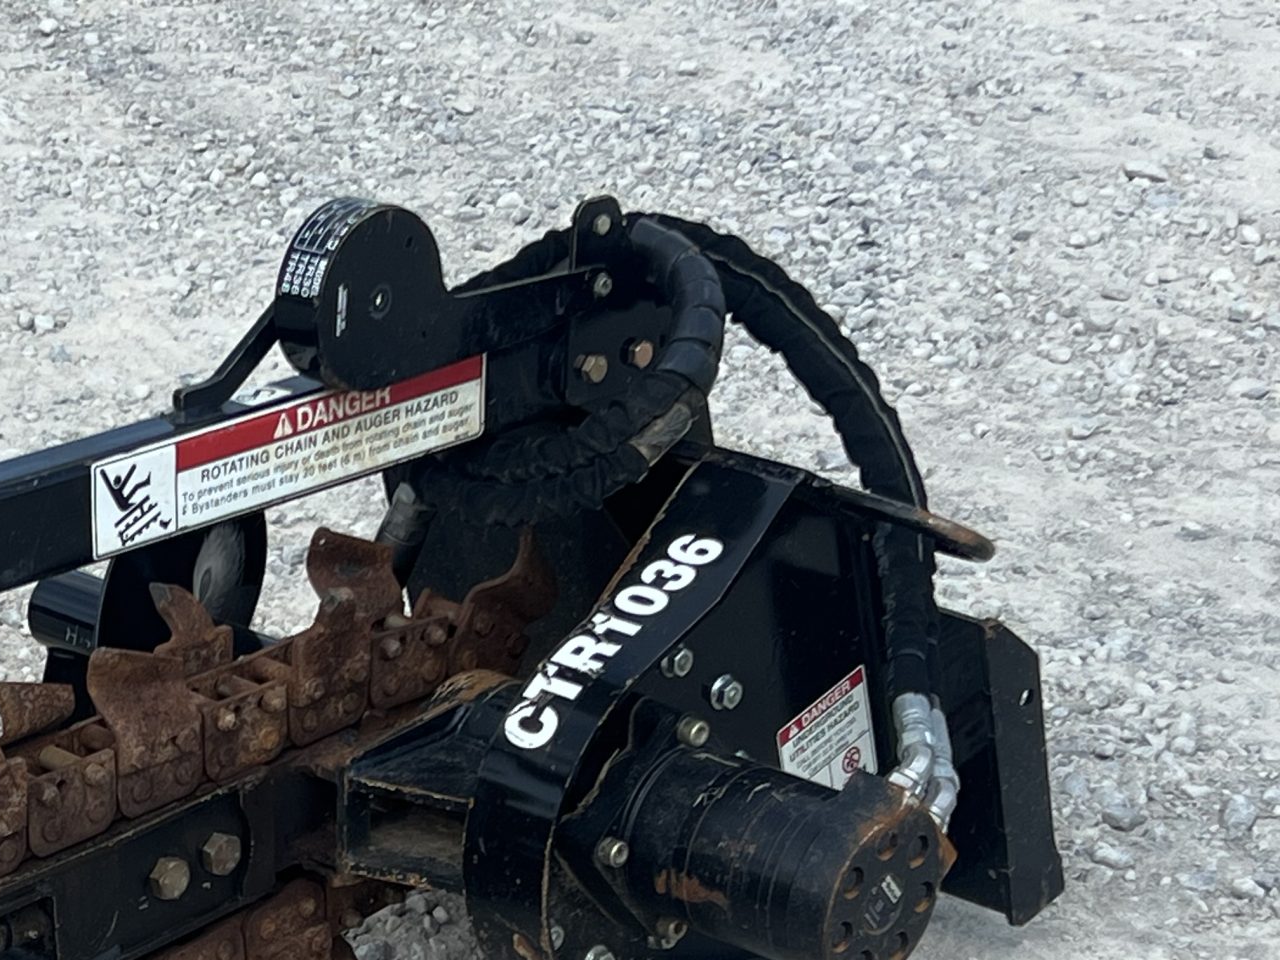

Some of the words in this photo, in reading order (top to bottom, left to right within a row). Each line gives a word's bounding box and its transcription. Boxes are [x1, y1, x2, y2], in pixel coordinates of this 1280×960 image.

[281, 250, 301, 293] TR48
[291, 253, 310, 296] TR36
[301, 255, 320, 298] TR30
[296, 386, 391, 432] DANGER
[182, 491, 195, 503] To
[197, 480, 233, 500] prevent
[236, 469, 270, 484] serious
[273, 460, 299, 475] injury
[342, 438, 363, 451] from
[365, 427, 400, 444] rotating
[402, 419, 426, 432] chain
[429, 410, 446, 424] and
[200, 449, 270, 483] ROTATING
[275, 434, 317, 459] CHAIN
[322, 425, 350, 445] AND
[355, 409, 400, 434] AUGER
[405, 391, 458, 418] HAZARD
[192, 487, 248, 515] Bystanders
[252, 479, 275, 494] must
[279, 472, 299, 486] stay
[318, 458, 337, 473] feet
[368, 442, 390, 457] from
[393, 432, 419, 449] chain
[422, 424, 440, 440] and
[503, 532, 725, 750] CTR1036
[792, 693, 854, 748] UNDERGROUND
[801, 680, 851, 727] DANGER
[789, 728, 826, 762] UTILITIES
[826, 701, 860, 732] HAZARD
